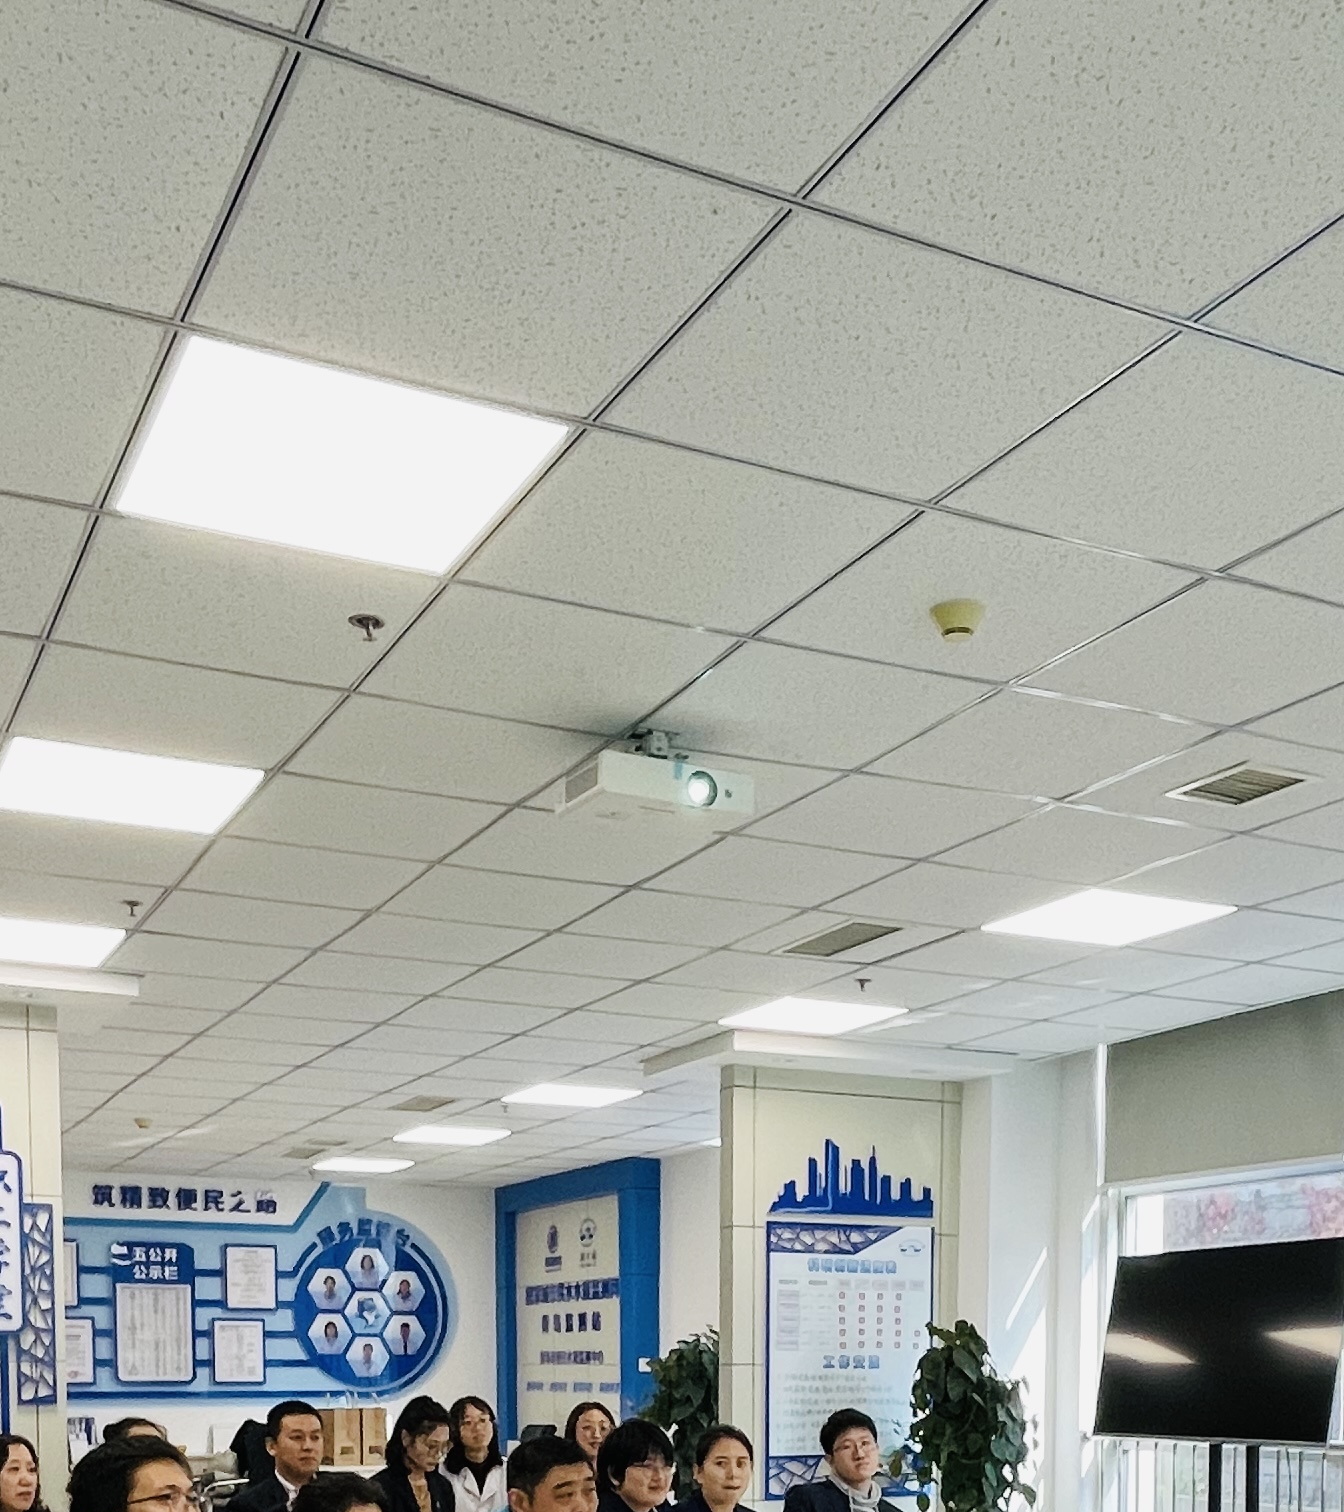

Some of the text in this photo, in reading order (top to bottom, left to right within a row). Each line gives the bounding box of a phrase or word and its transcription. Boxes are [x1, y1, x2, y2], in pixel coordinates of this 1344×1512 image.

[132, 1246, 177, 1262] 五公开
[133, 1264, 178, 1280] 公示栏
